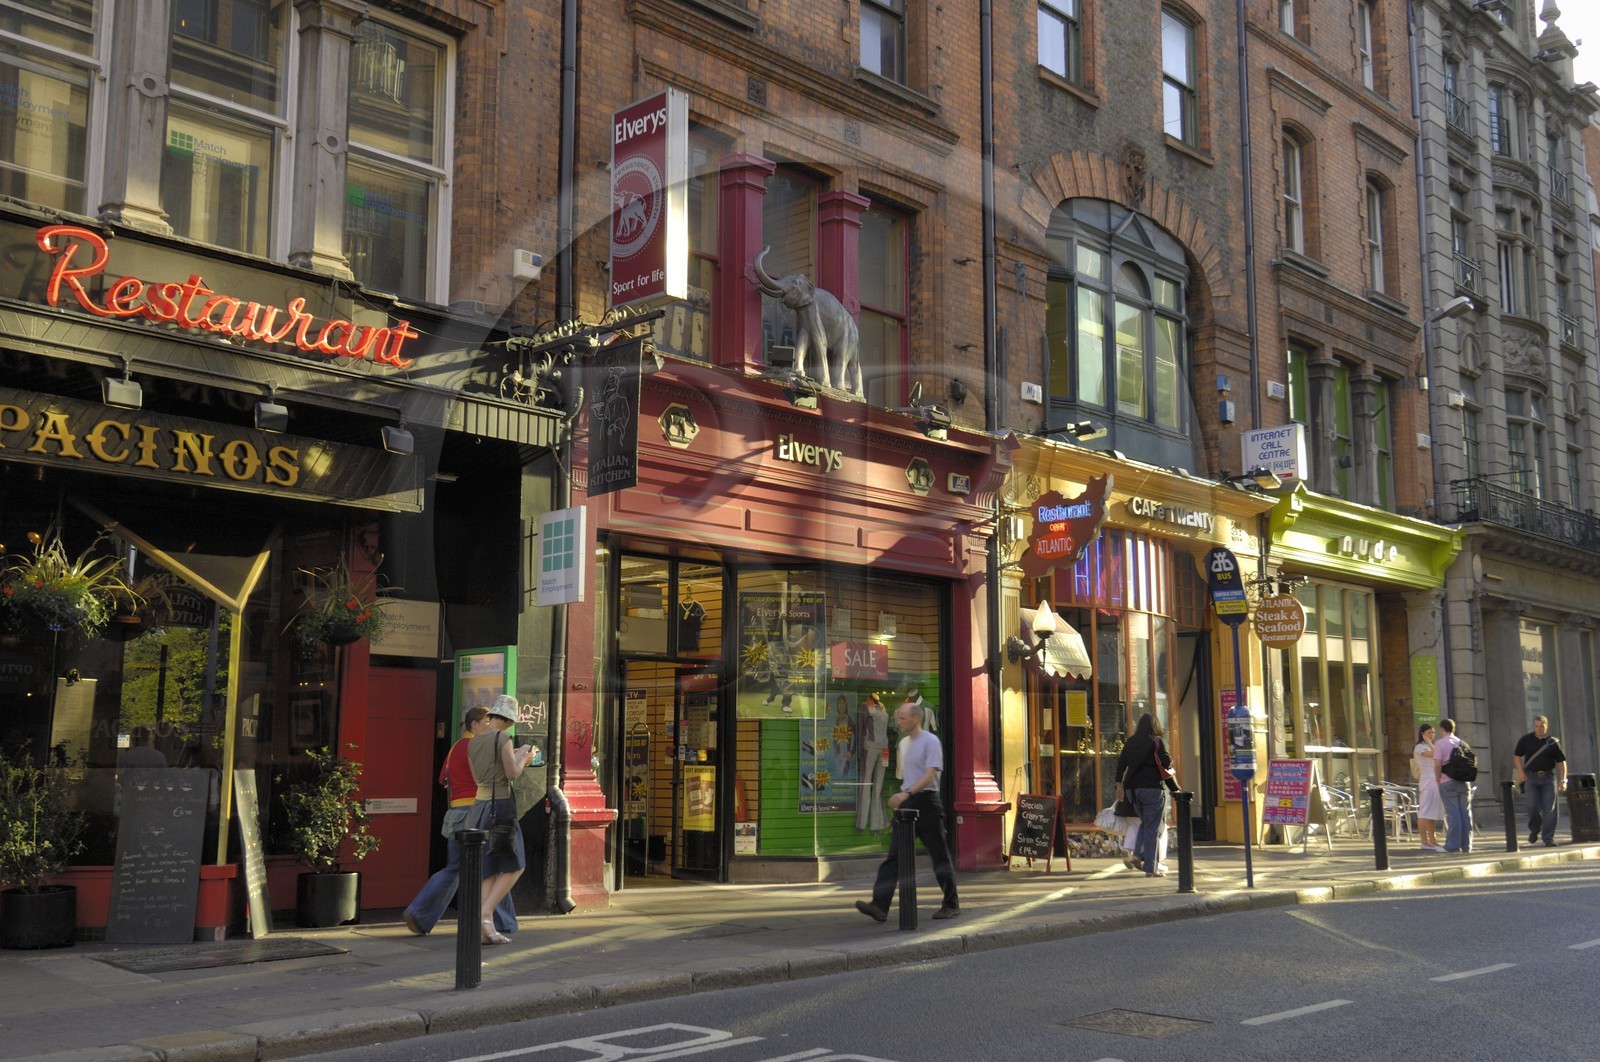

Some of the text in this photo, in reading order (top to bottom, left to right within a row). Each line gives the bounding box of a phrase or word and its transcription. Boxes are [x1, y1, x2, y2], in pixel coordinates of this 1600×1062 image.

[615, 107, 667, 144] Elverys
[194, 138, 227, 155] Match
[613, 268, 665, 295] Sport for life
[36, 225, 419, 369] Restaurant
[1251, 429, 1292, 442] INTERNET
[0, 403, 300, 487] PACINOS
[1261, 440, 1282, 450] CALL
[779, 433, 843, 473] Elverys
[1258, 448, 1290, 460] CENTRE
[592, 454, 629, 474] ITALIAN
[590, 469, 631, 487] KITCHEN
[1038, 500, 1091, 523] Restaurant
[1035, 537, 1072, 554] ATLANTIC
[1343, 535, 1397, 562] nude
[542, 578, 556, 586] Match
[1217, 572, 1232, 580] BUS
[541, 583, 573, 593] Employment
[1260, 598, 1295, 608] ATLANTIC
[757, 607, 811, 620] Elverys Sports
[1256, 610, 1300, 622] Steak &
[379, 622, 431, 631] Employment
[1257, 621, 1301, 633] Seafood
[1262, 633, 1297, 642] Restaurant
[844, 648, 876, 668] SALE
